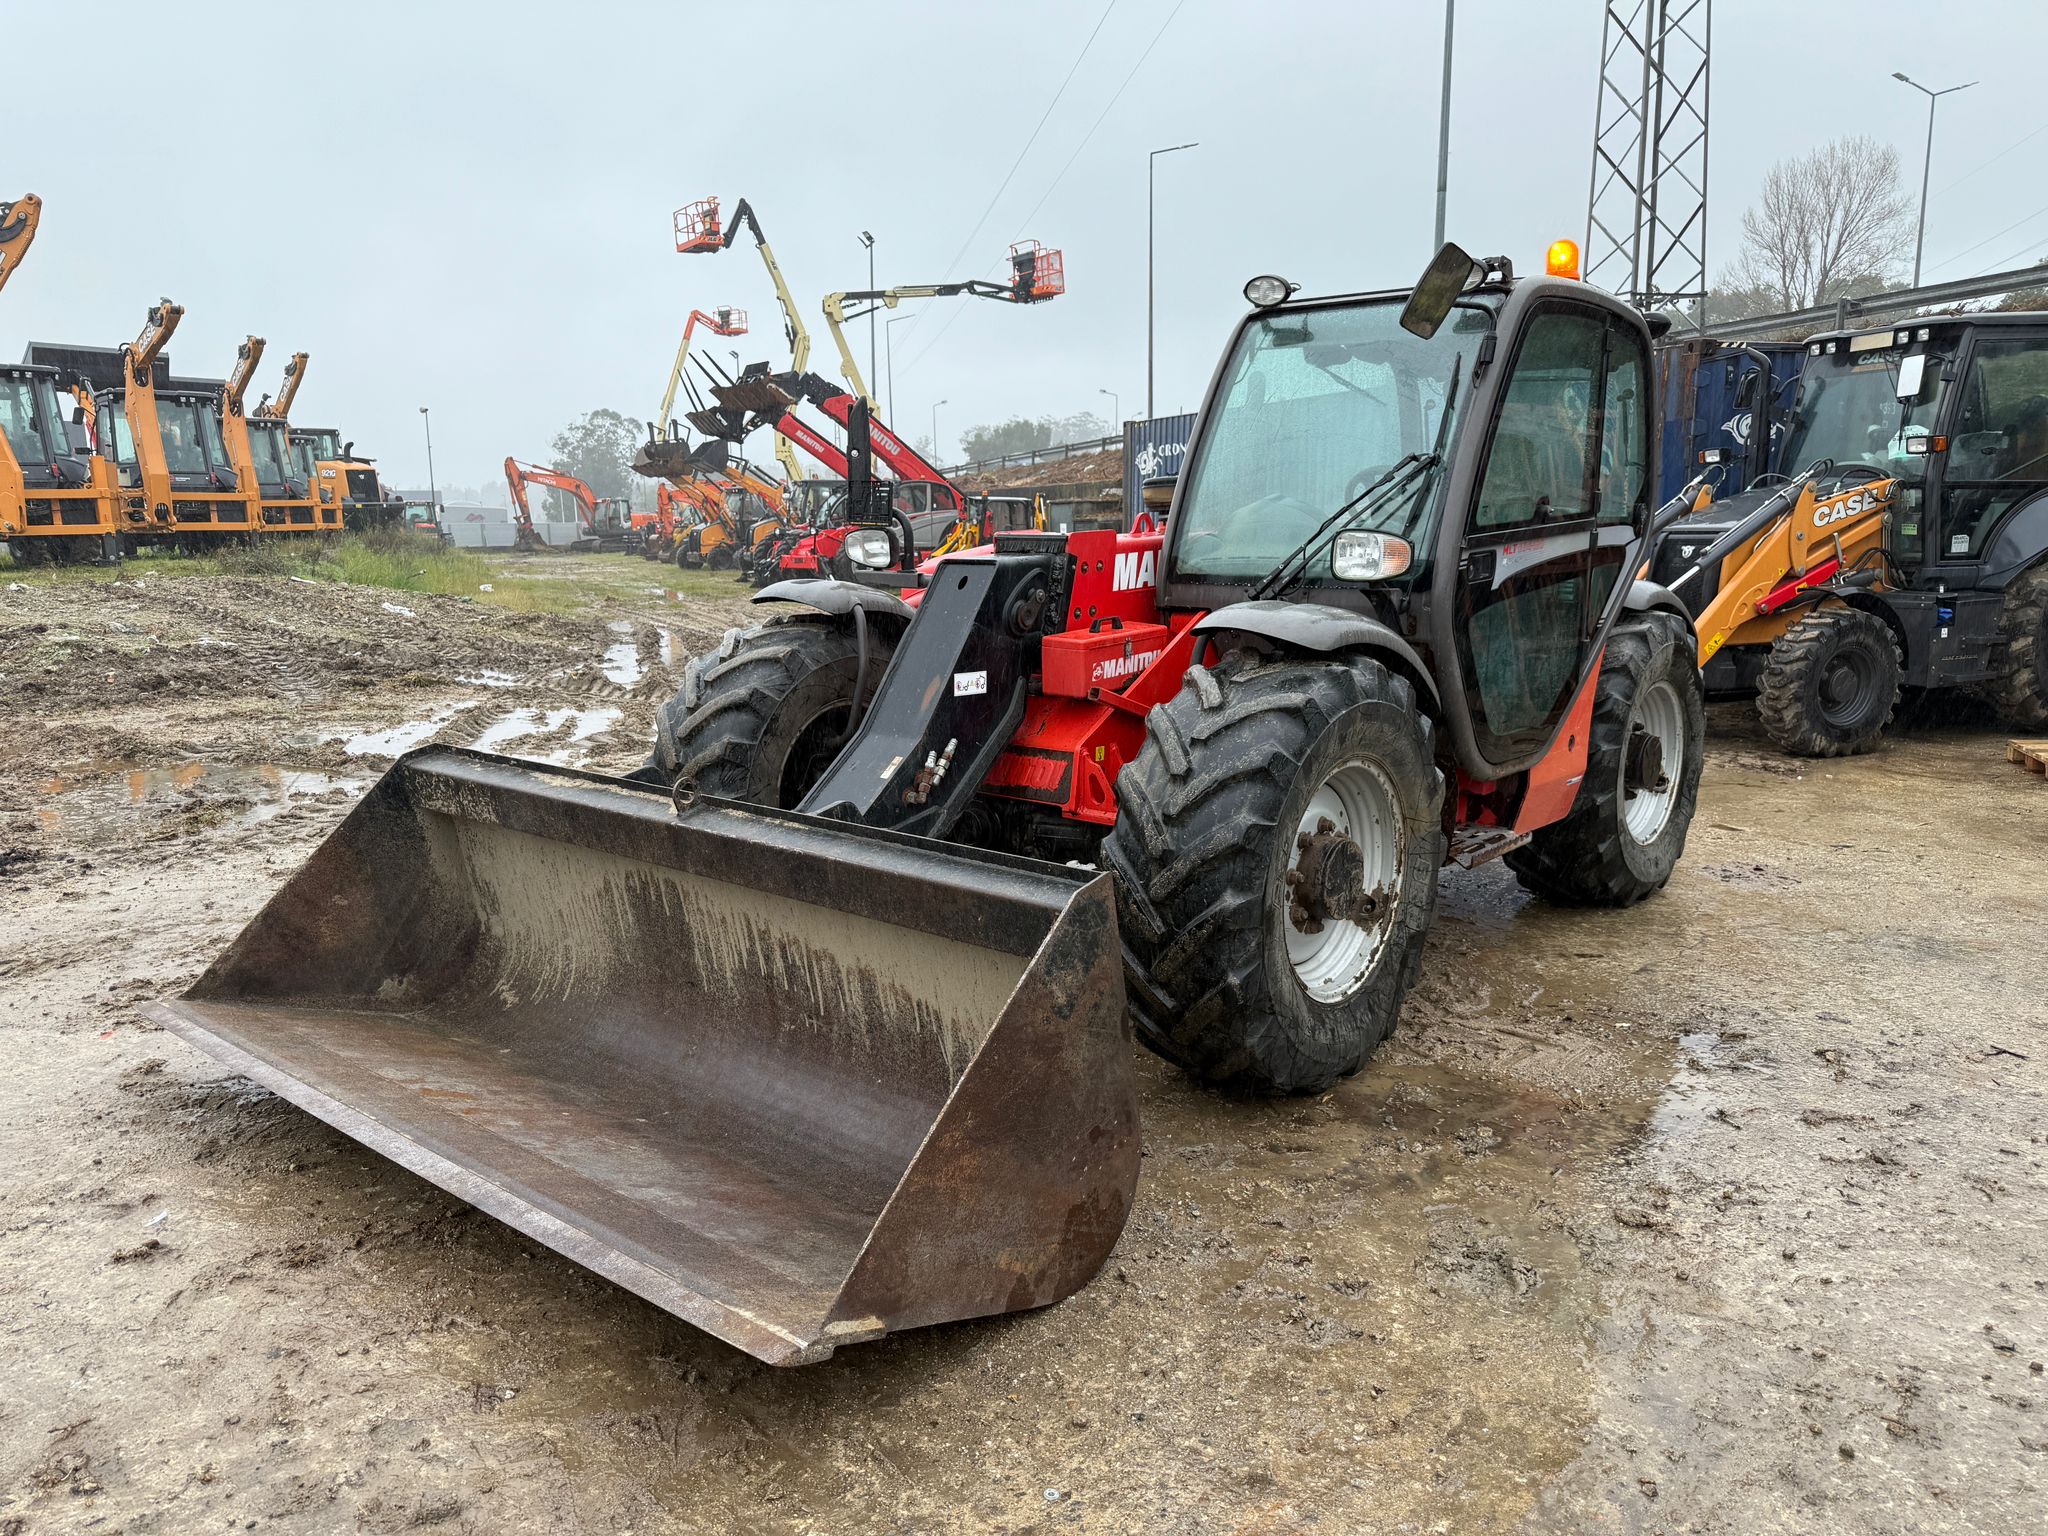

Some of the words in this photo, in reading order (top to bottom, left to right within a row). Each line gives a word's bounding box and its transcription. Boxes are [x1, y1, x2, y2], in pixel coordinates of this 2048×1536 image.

[138, 321, 155, 353] CASE
[795, 430, 825, 453] MANITOU
[1812, 488, 1879, 528] CASE
[1112, 549, 1162, 592] MA
